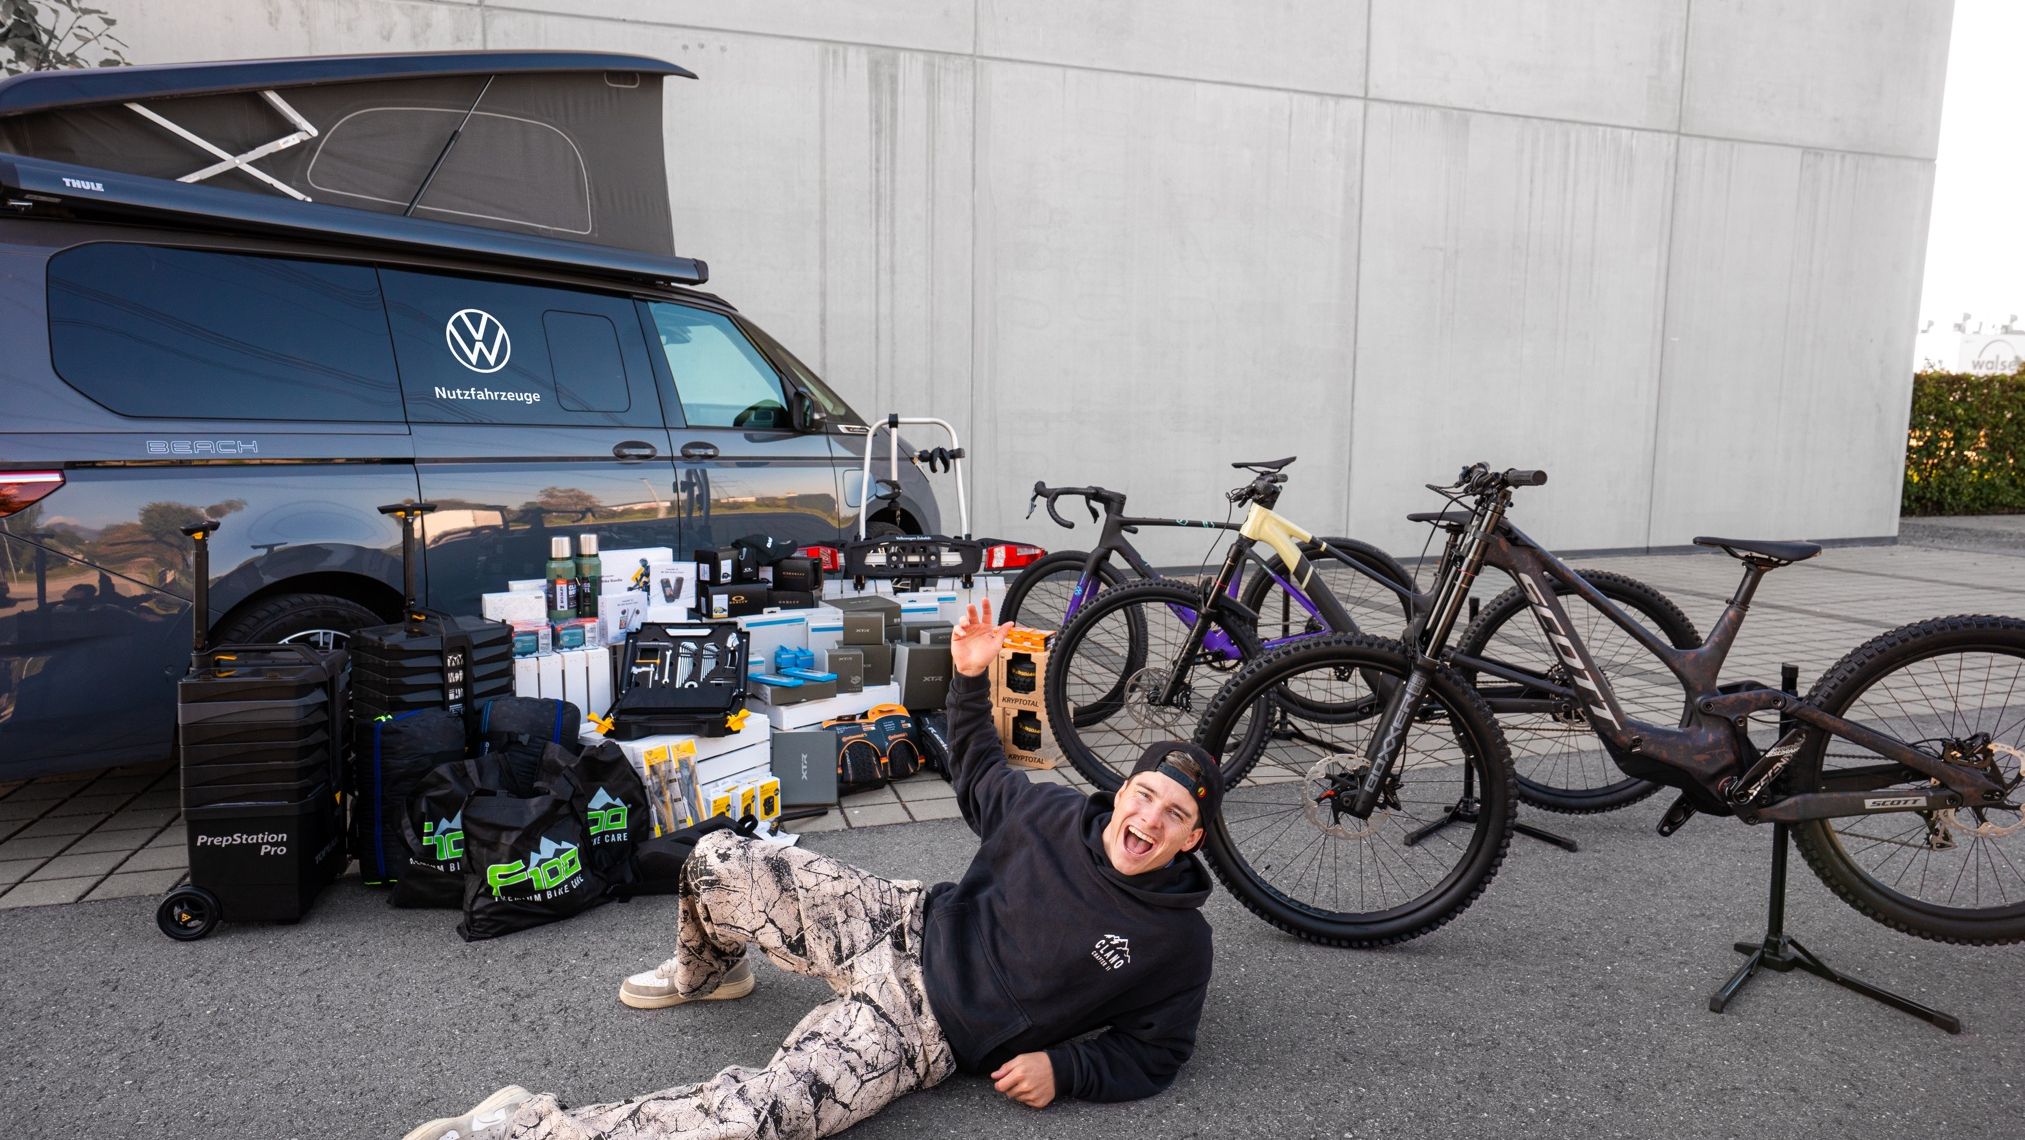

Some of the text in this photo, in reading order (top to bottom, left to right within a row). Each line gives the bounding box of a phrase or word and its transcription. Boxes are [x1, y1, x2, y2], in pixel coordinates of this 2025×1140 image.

[62, 177, 104, 192] THULE
[1972, 354, 2018, 371] walse
[434, 386, 541, 404] Nutzfahrzeuge
[146, 440, 258, 454] BEACH
[1518, 572, 1622, 731] SCOTT
[1002, 696, 1039, 708] KRYPTOTAL
[1364, 693, 1416, 793] BOXXER
[1008, 753, 1045, 765] KRYPTOTAL
[1869, 798, 1921, 808] SCOTT
[196, 832, 288, 848] PrepStation
[604, 832, 628, 843] CARE
[260, 844, 287, 856] Pro
[546, 884, 570, 899] BIKE
[1095, 939, 1125, 969] CLANO
